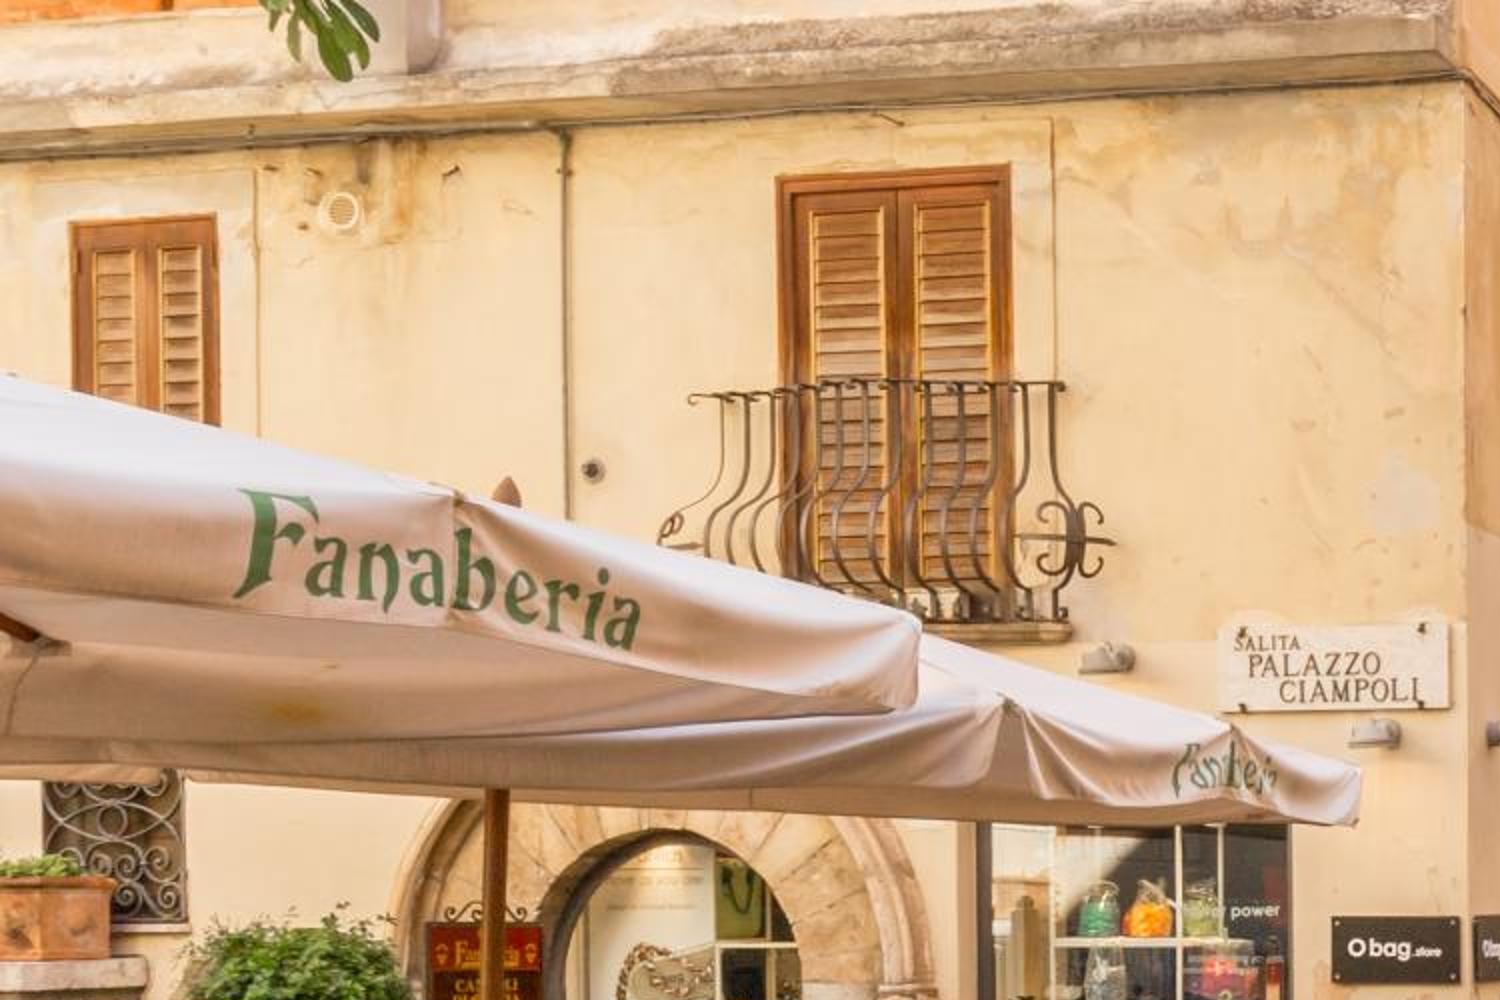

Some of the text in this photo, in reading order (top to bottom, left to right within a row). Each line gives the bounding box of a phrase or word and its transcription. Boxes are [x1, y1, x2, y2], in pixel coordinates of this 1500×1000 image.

[232, 487, 641, 651] Fanaberia
[1233, 633, 1302, 652] SALITA
[1248, 651, 1382, 679] PALAZZO
[1279, 676, 1420, 704] CIAMPOLI
[1230, 904, 1281, 921] power
[1347, 938, 1367, 958] O
